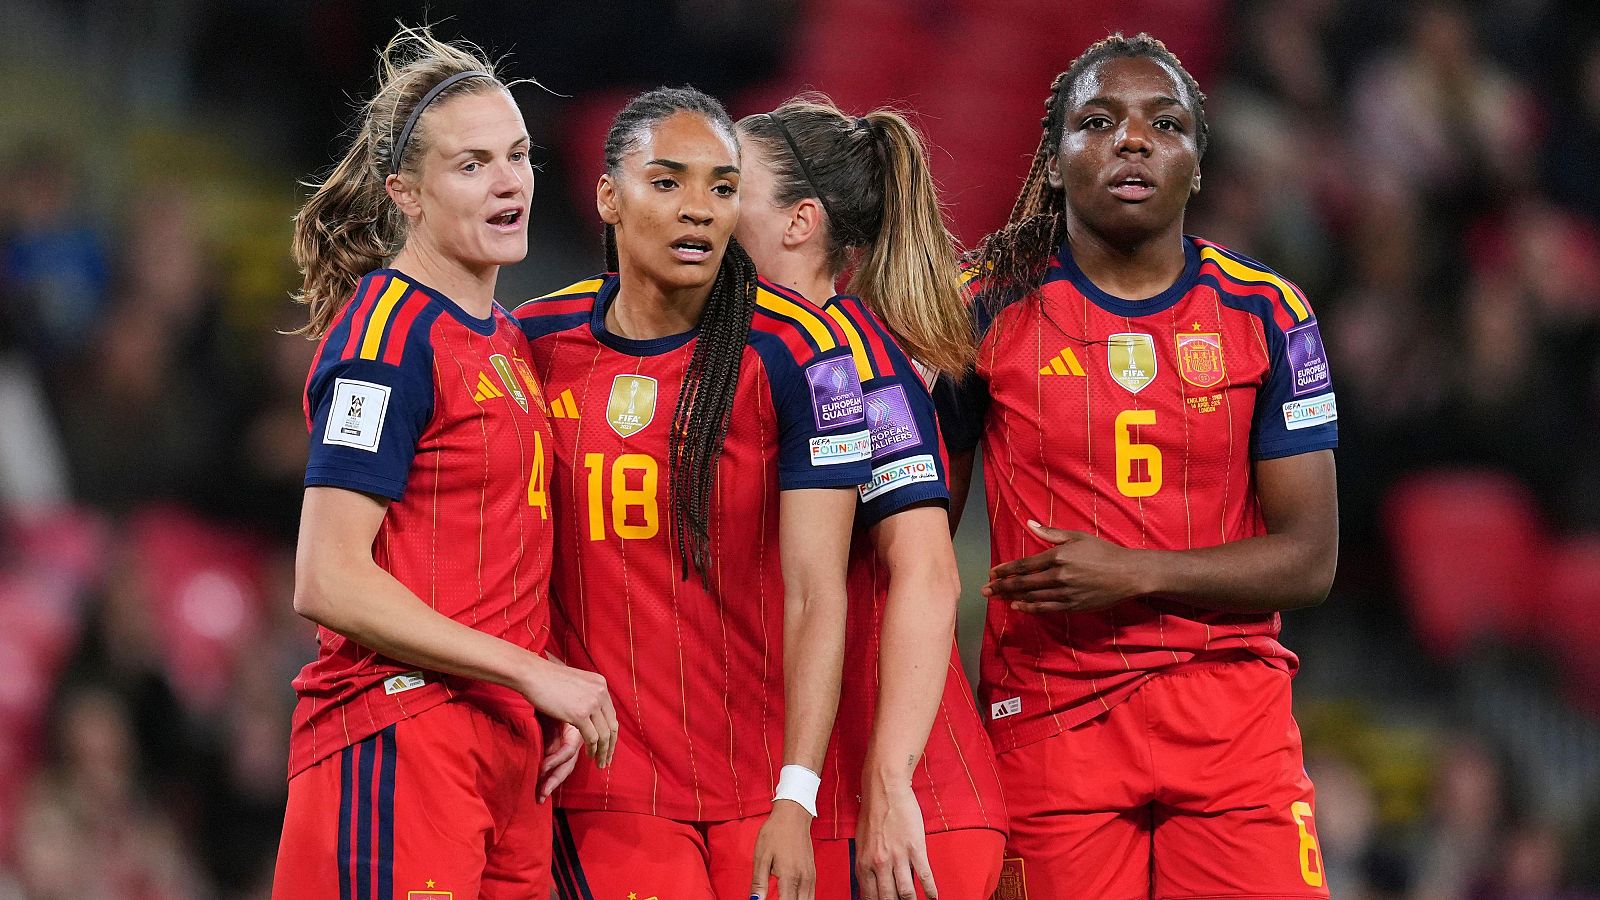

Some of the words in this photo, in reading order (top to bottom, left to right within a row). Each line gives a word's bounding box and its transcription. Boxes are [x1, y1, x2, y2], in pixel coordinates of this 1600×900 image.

[1122, 369, 1144, 377] FIFA
[1297, 362, 1326, 378] EUROPEAN
[821, 397, 862, 412] EUROPEAN
[1186, 396, 1207, 404] ENGLAND
[1284, 402, 1301, 411] UEFA
[617, 414, 639, 424] FIFA
[822, 405, 863, 421] QUALIFIERS
[871, 424, 910, 443] ROPEAN
[871, 432, 913, 451] UALIFIERS
[811, 438, 831, 446] UEFA
[1114, 409, 1163, 498] 6
[527, 431, 547, 520] 4
[584, 453, 659, 541] 18
[1291, 801, 1323, 888] 6
